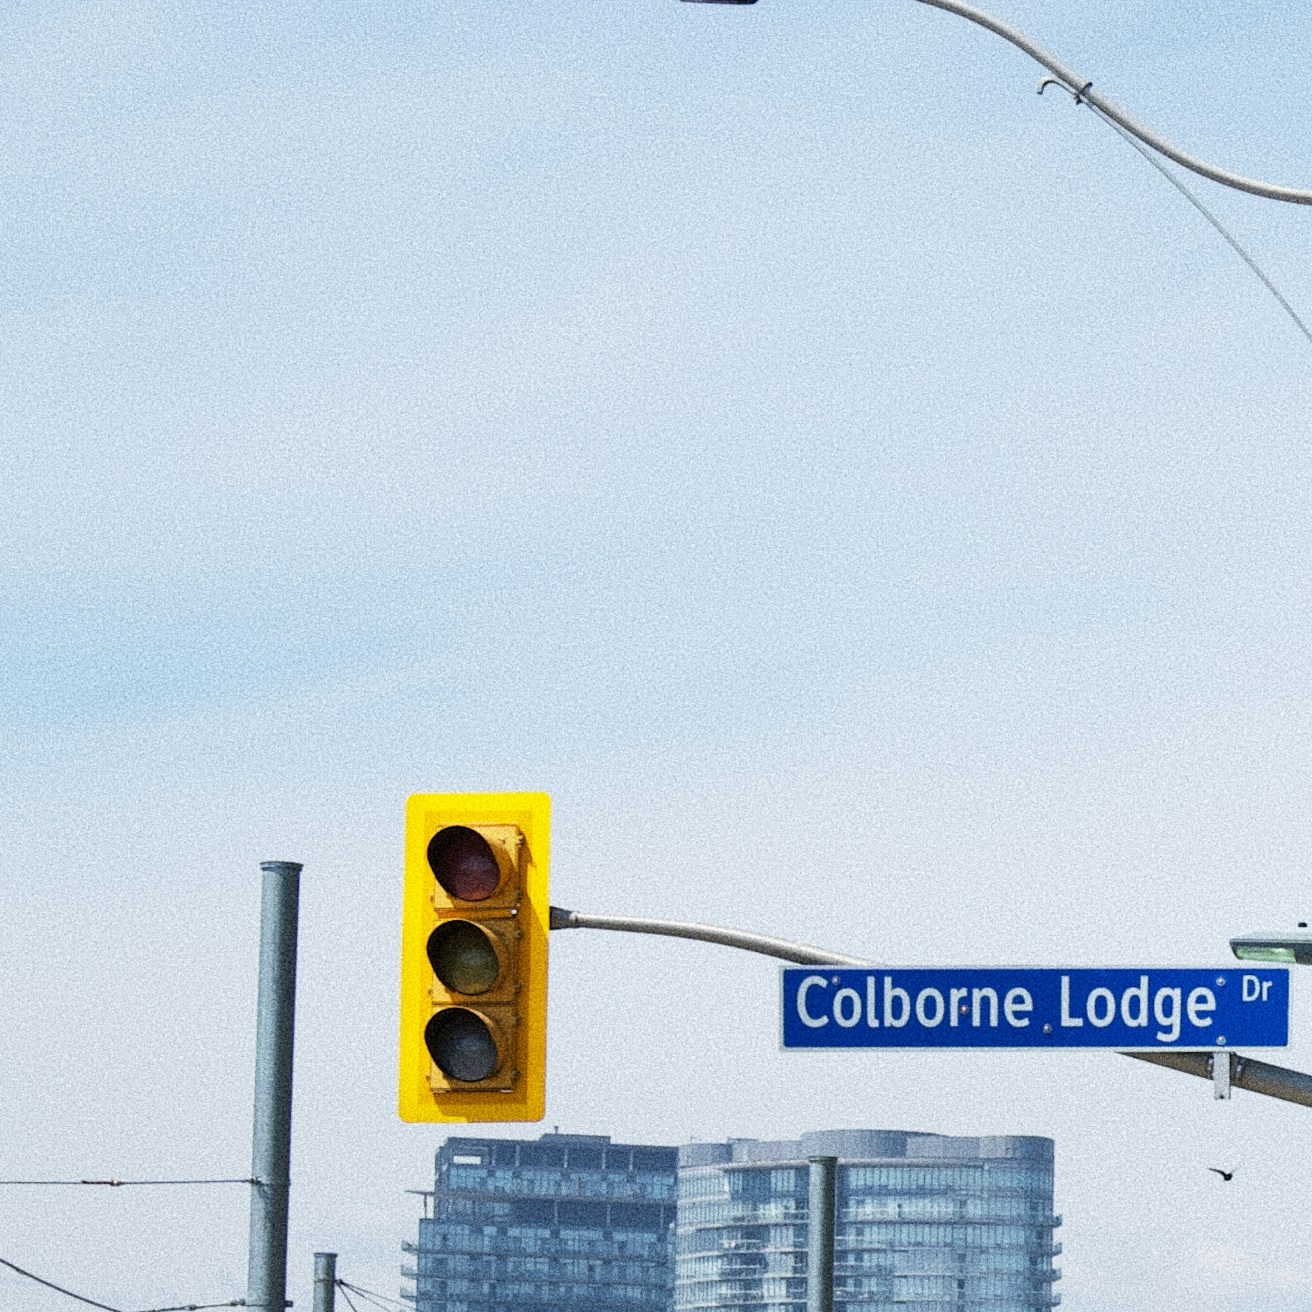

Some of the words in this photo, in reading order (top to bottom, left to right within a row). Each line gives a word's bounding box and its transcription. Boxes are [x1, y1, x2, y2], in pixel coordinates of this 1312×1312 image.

[796, 975, 1034, 1029] Colborne
[1060, 974, 1217, 1042] Lodge
[1242, 974, 1272, 1002] Dr
